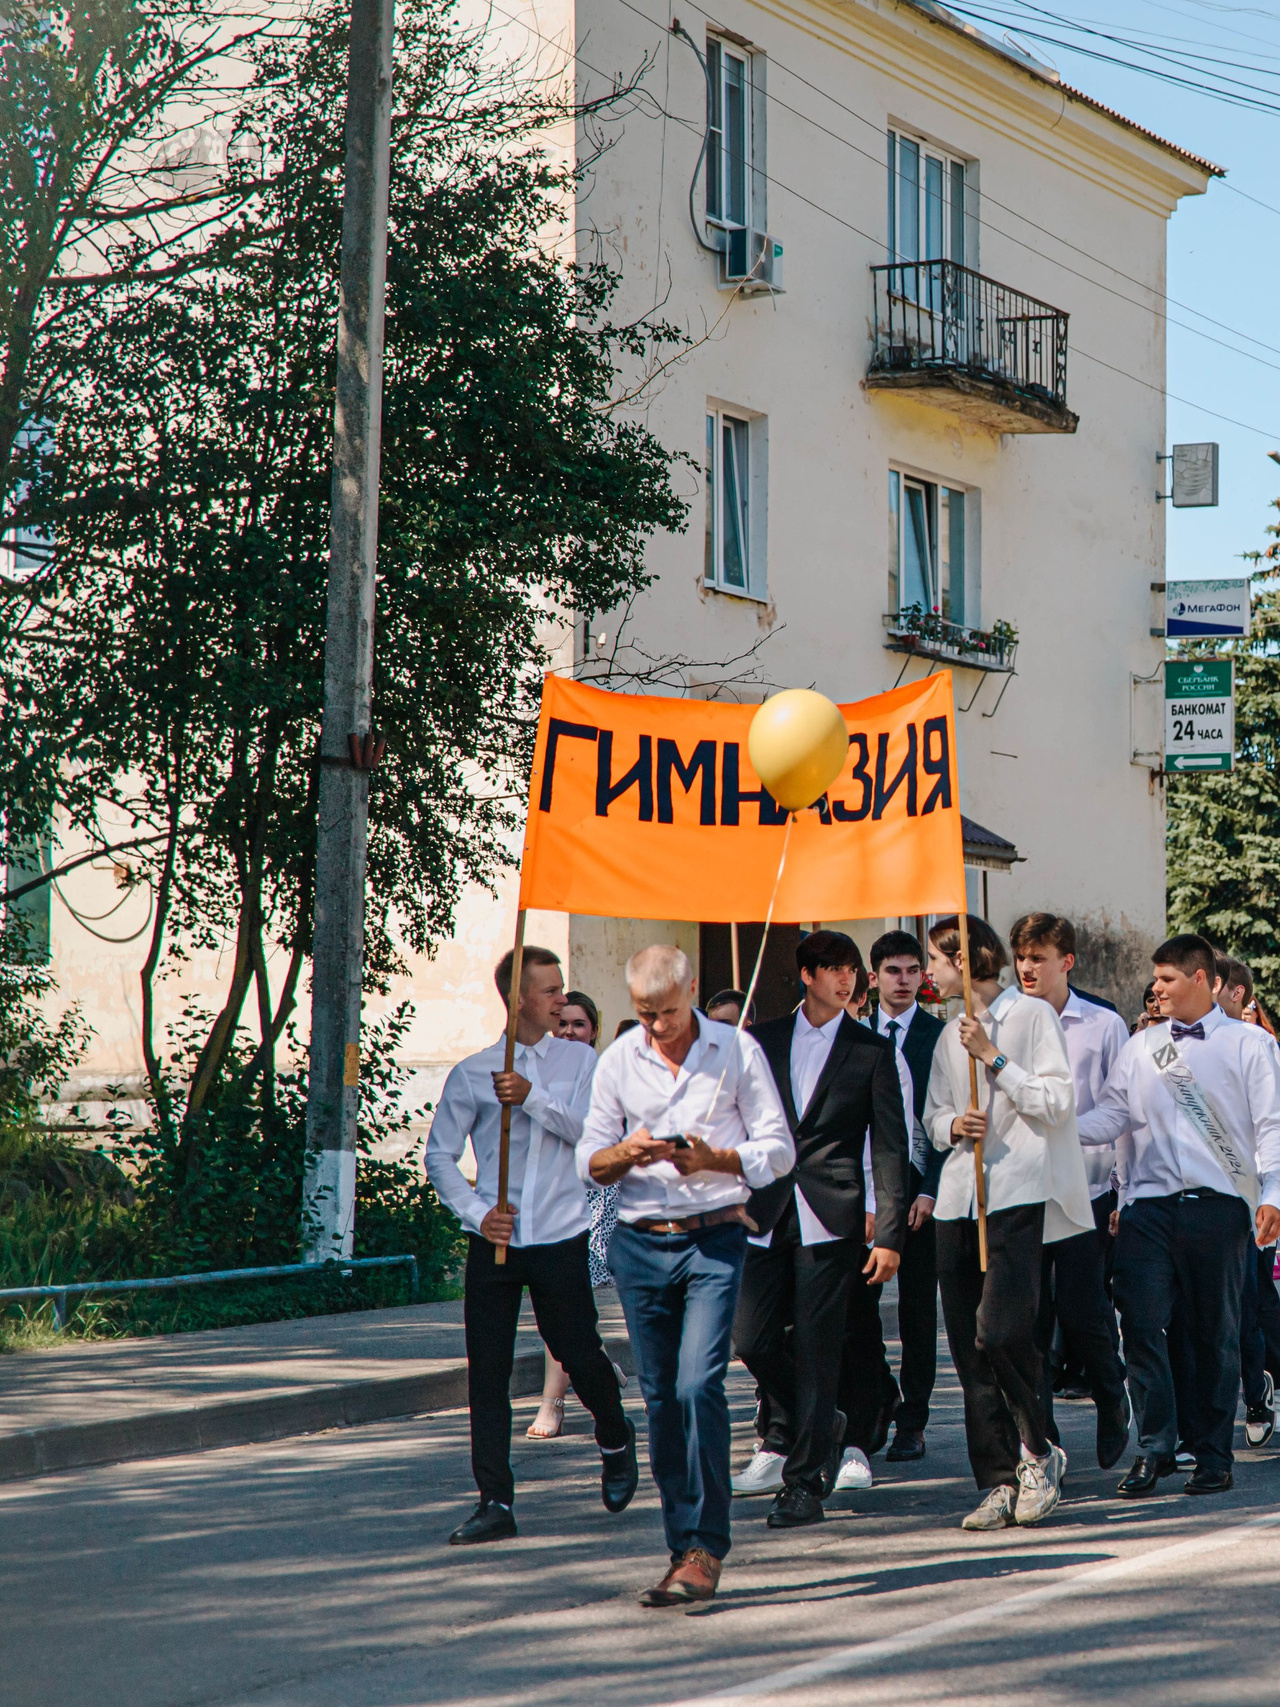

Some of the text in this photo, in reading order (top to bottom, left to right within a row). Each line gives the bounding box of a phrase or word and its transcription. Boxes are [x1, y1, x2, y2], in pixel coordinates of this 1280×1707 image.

[1178, 676, 1219, 684] СБЕРБАНК
[1171, 703, 1226, 716] БАНКОМАТ
[1173, 720, 1223, 741] 24 ЧАСА
[540, 715, 952, 826] ГИМНЗИЯ
[1165, 1065, 1225, 1144] Выпускник
[1218, 1143, 1247, 1178] 2024
